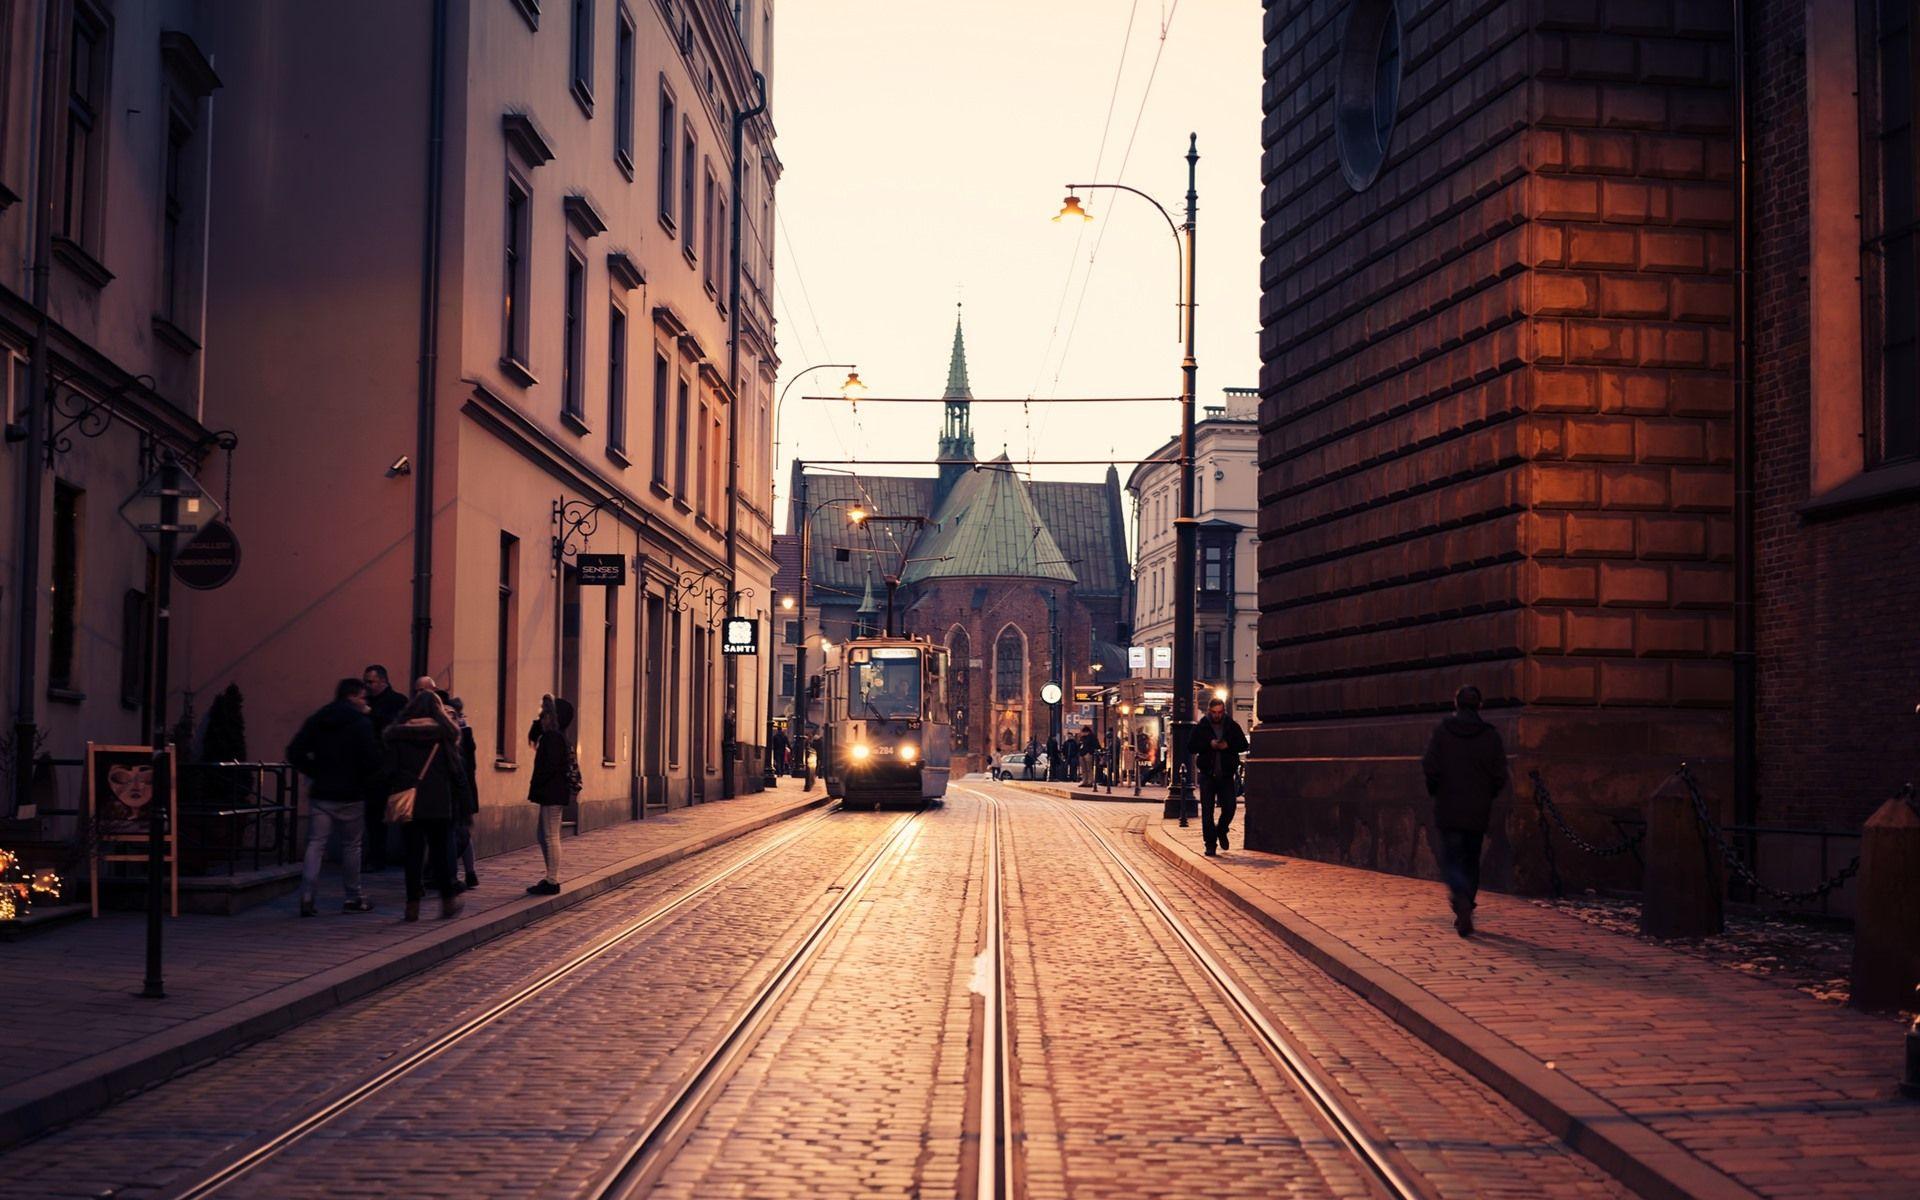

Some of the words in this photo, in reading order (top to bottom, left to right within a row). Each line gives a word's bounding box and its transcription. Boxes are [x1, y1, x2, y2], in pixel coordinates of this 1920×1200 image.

[582, 565, 619, 574] SENSES
[858, 650, 864, 661] 1
[853, 723, 859, 741] 1
[879, 746, 894, 755] 284
